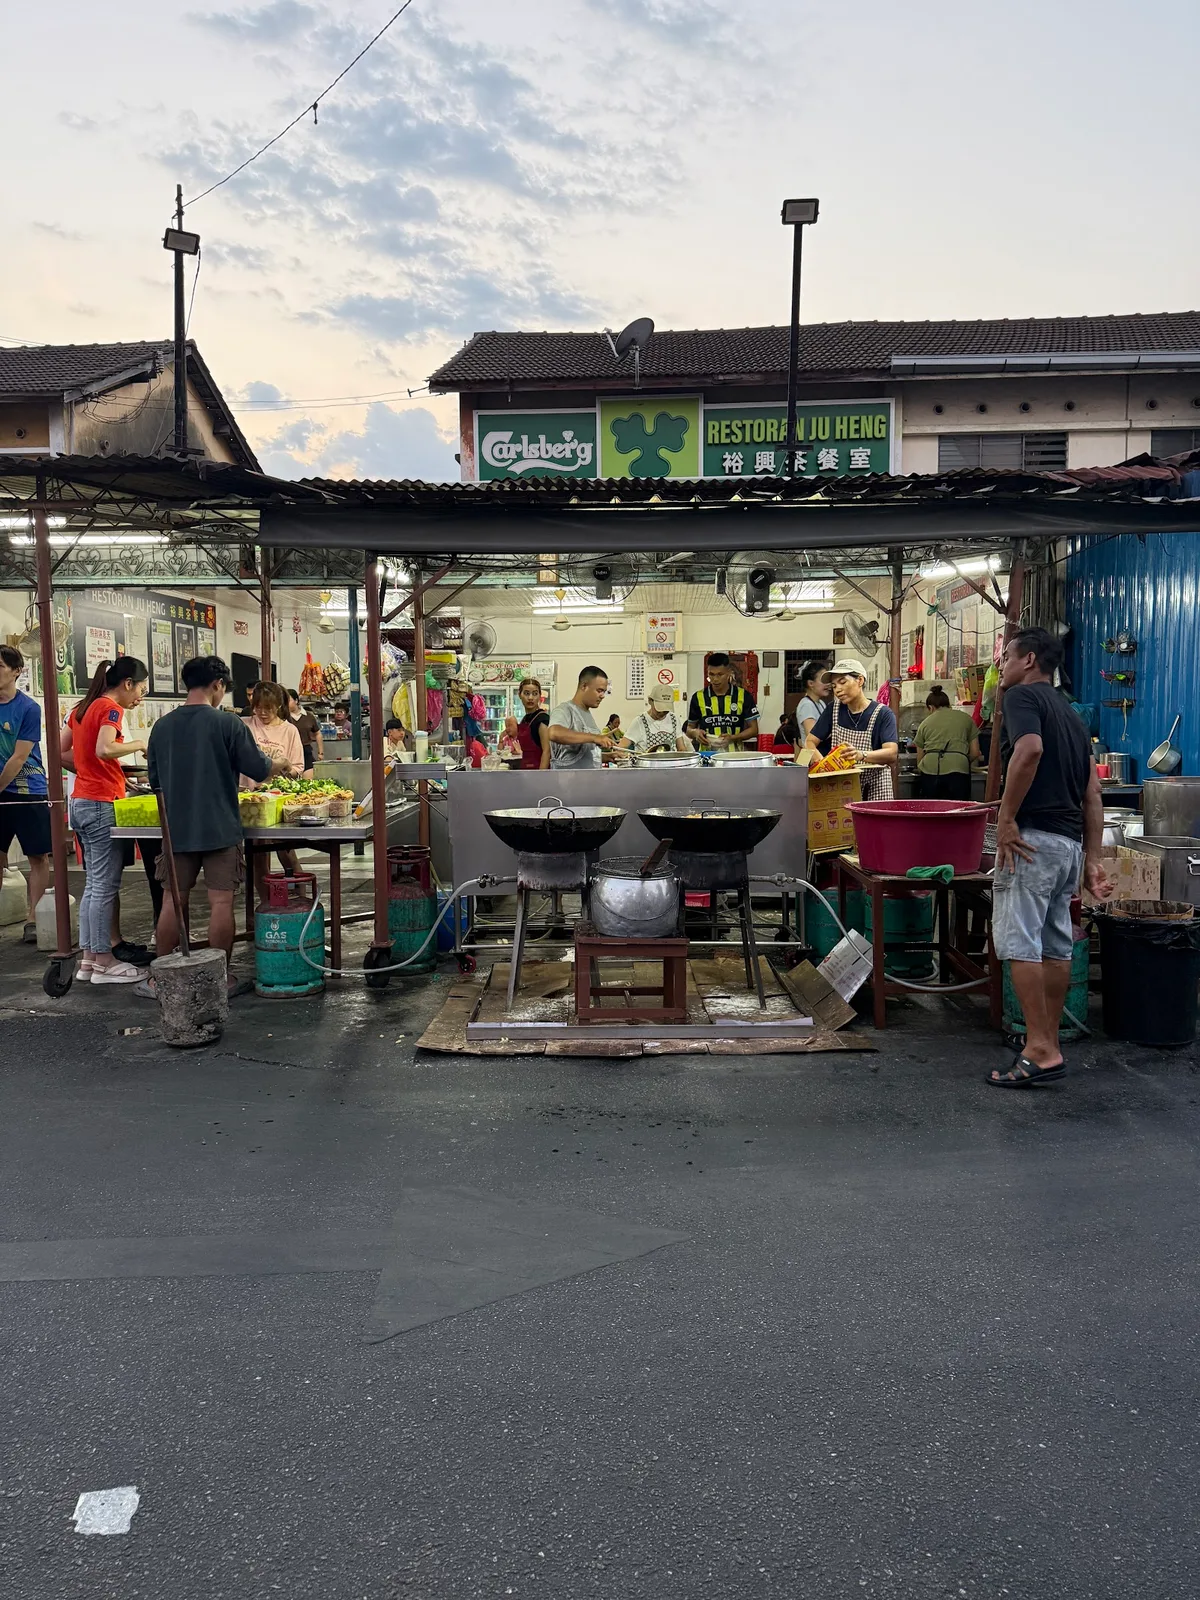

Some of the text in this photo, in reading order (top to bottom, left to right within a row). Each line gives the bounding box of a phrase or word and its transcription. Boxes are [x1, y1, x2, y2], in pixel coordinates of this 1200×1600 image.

[707, 414, 887, 444] RESTORAN JU HENG
[481, 430, 594, 471] Carlsberg
[91, 590, 166, 616] RESTORAN JU HENG
[265, 931, 287, 939] GAS
